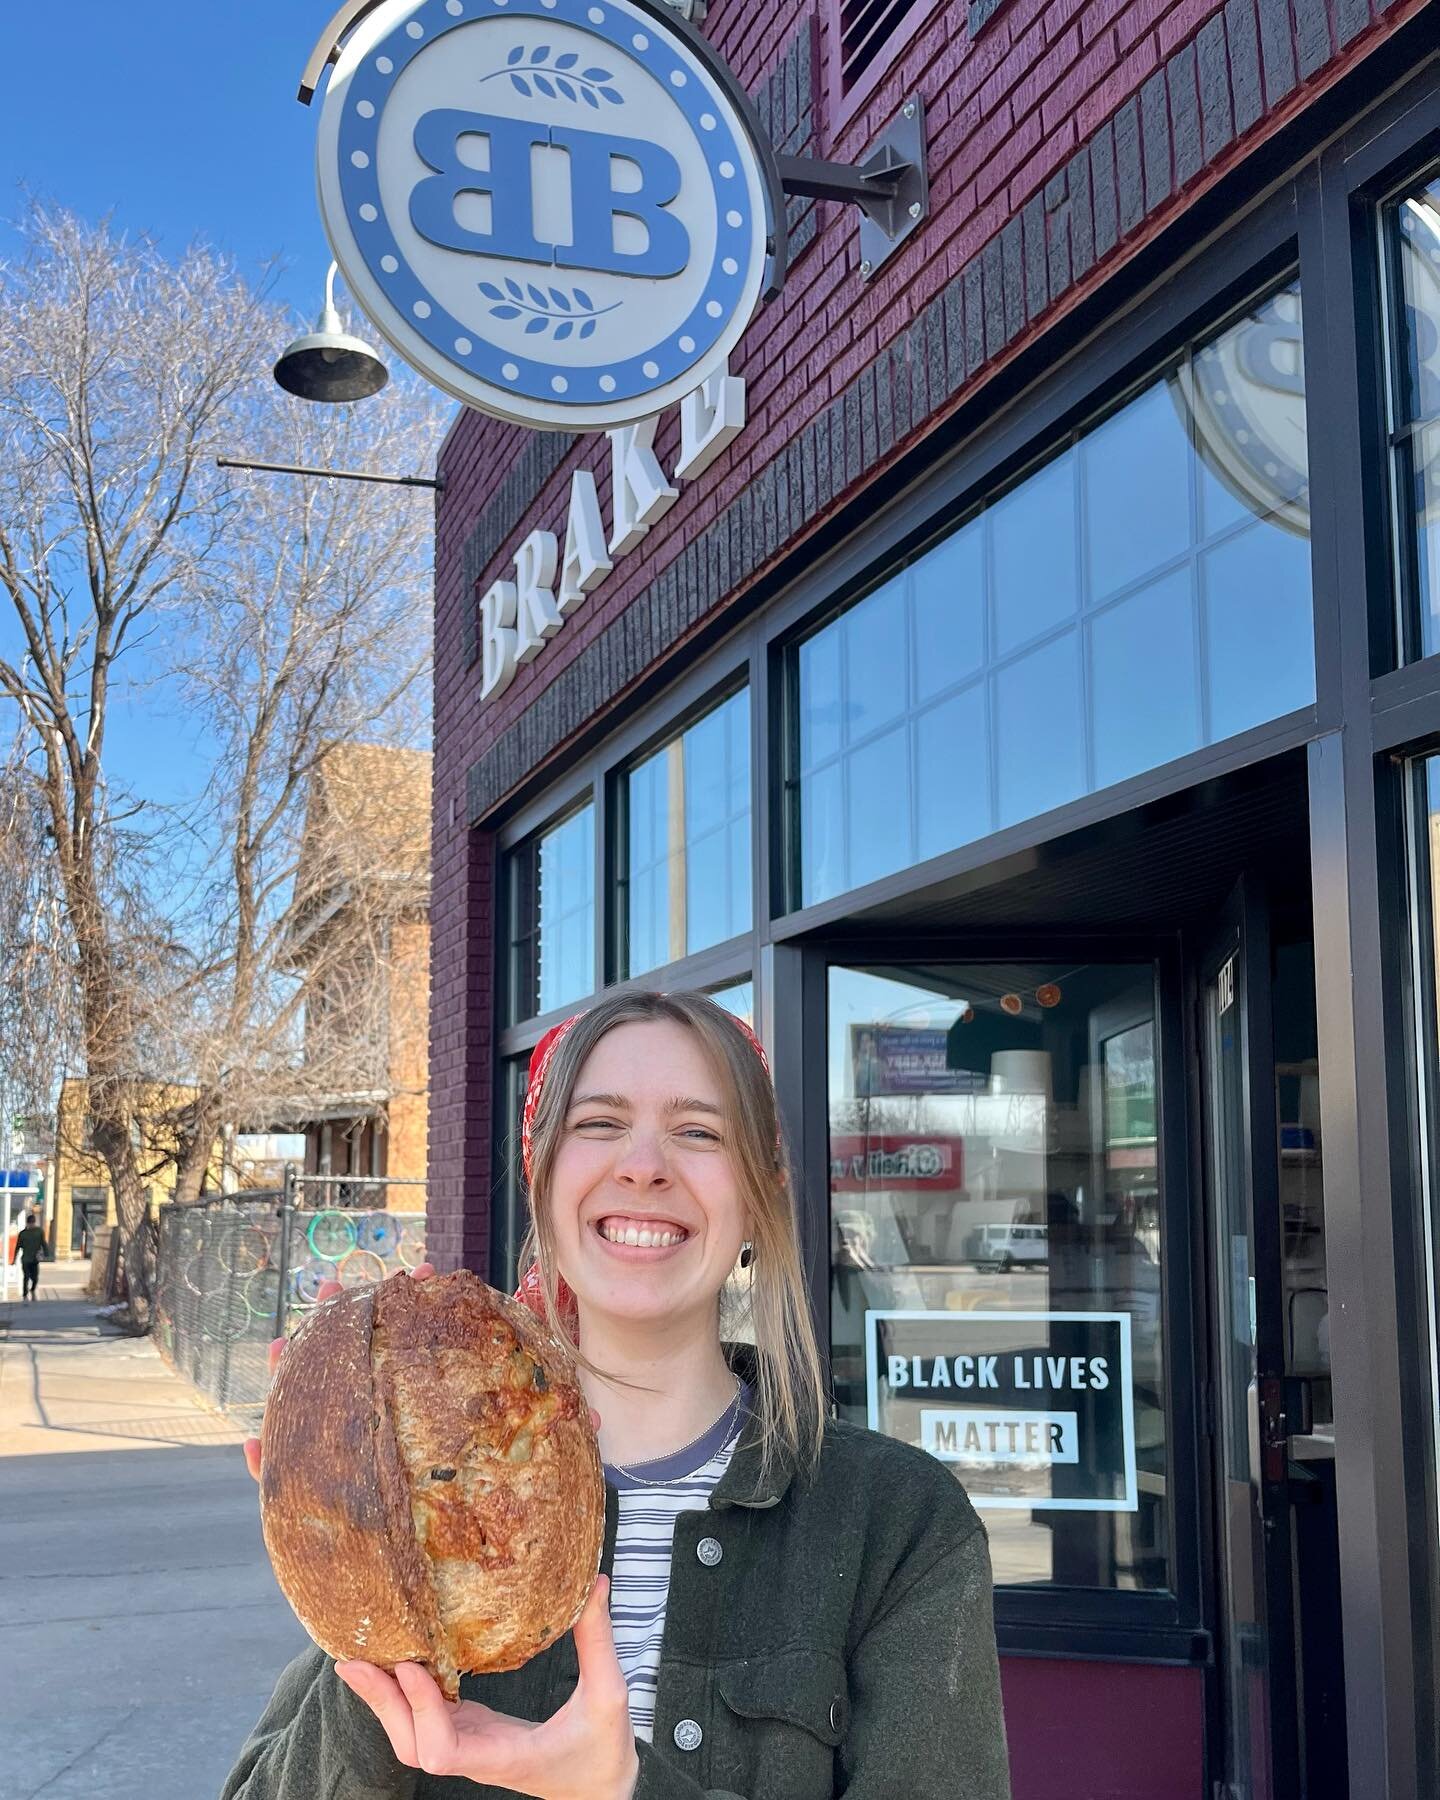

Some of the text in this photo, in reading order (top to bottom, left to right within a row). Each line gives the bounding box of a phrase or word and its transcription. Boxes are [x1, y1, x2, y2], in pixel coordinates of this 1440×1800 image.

[887, 1354, 1110, 1390] BLACK LIVES
[934, 1421, 1064, 1454] MATTER
